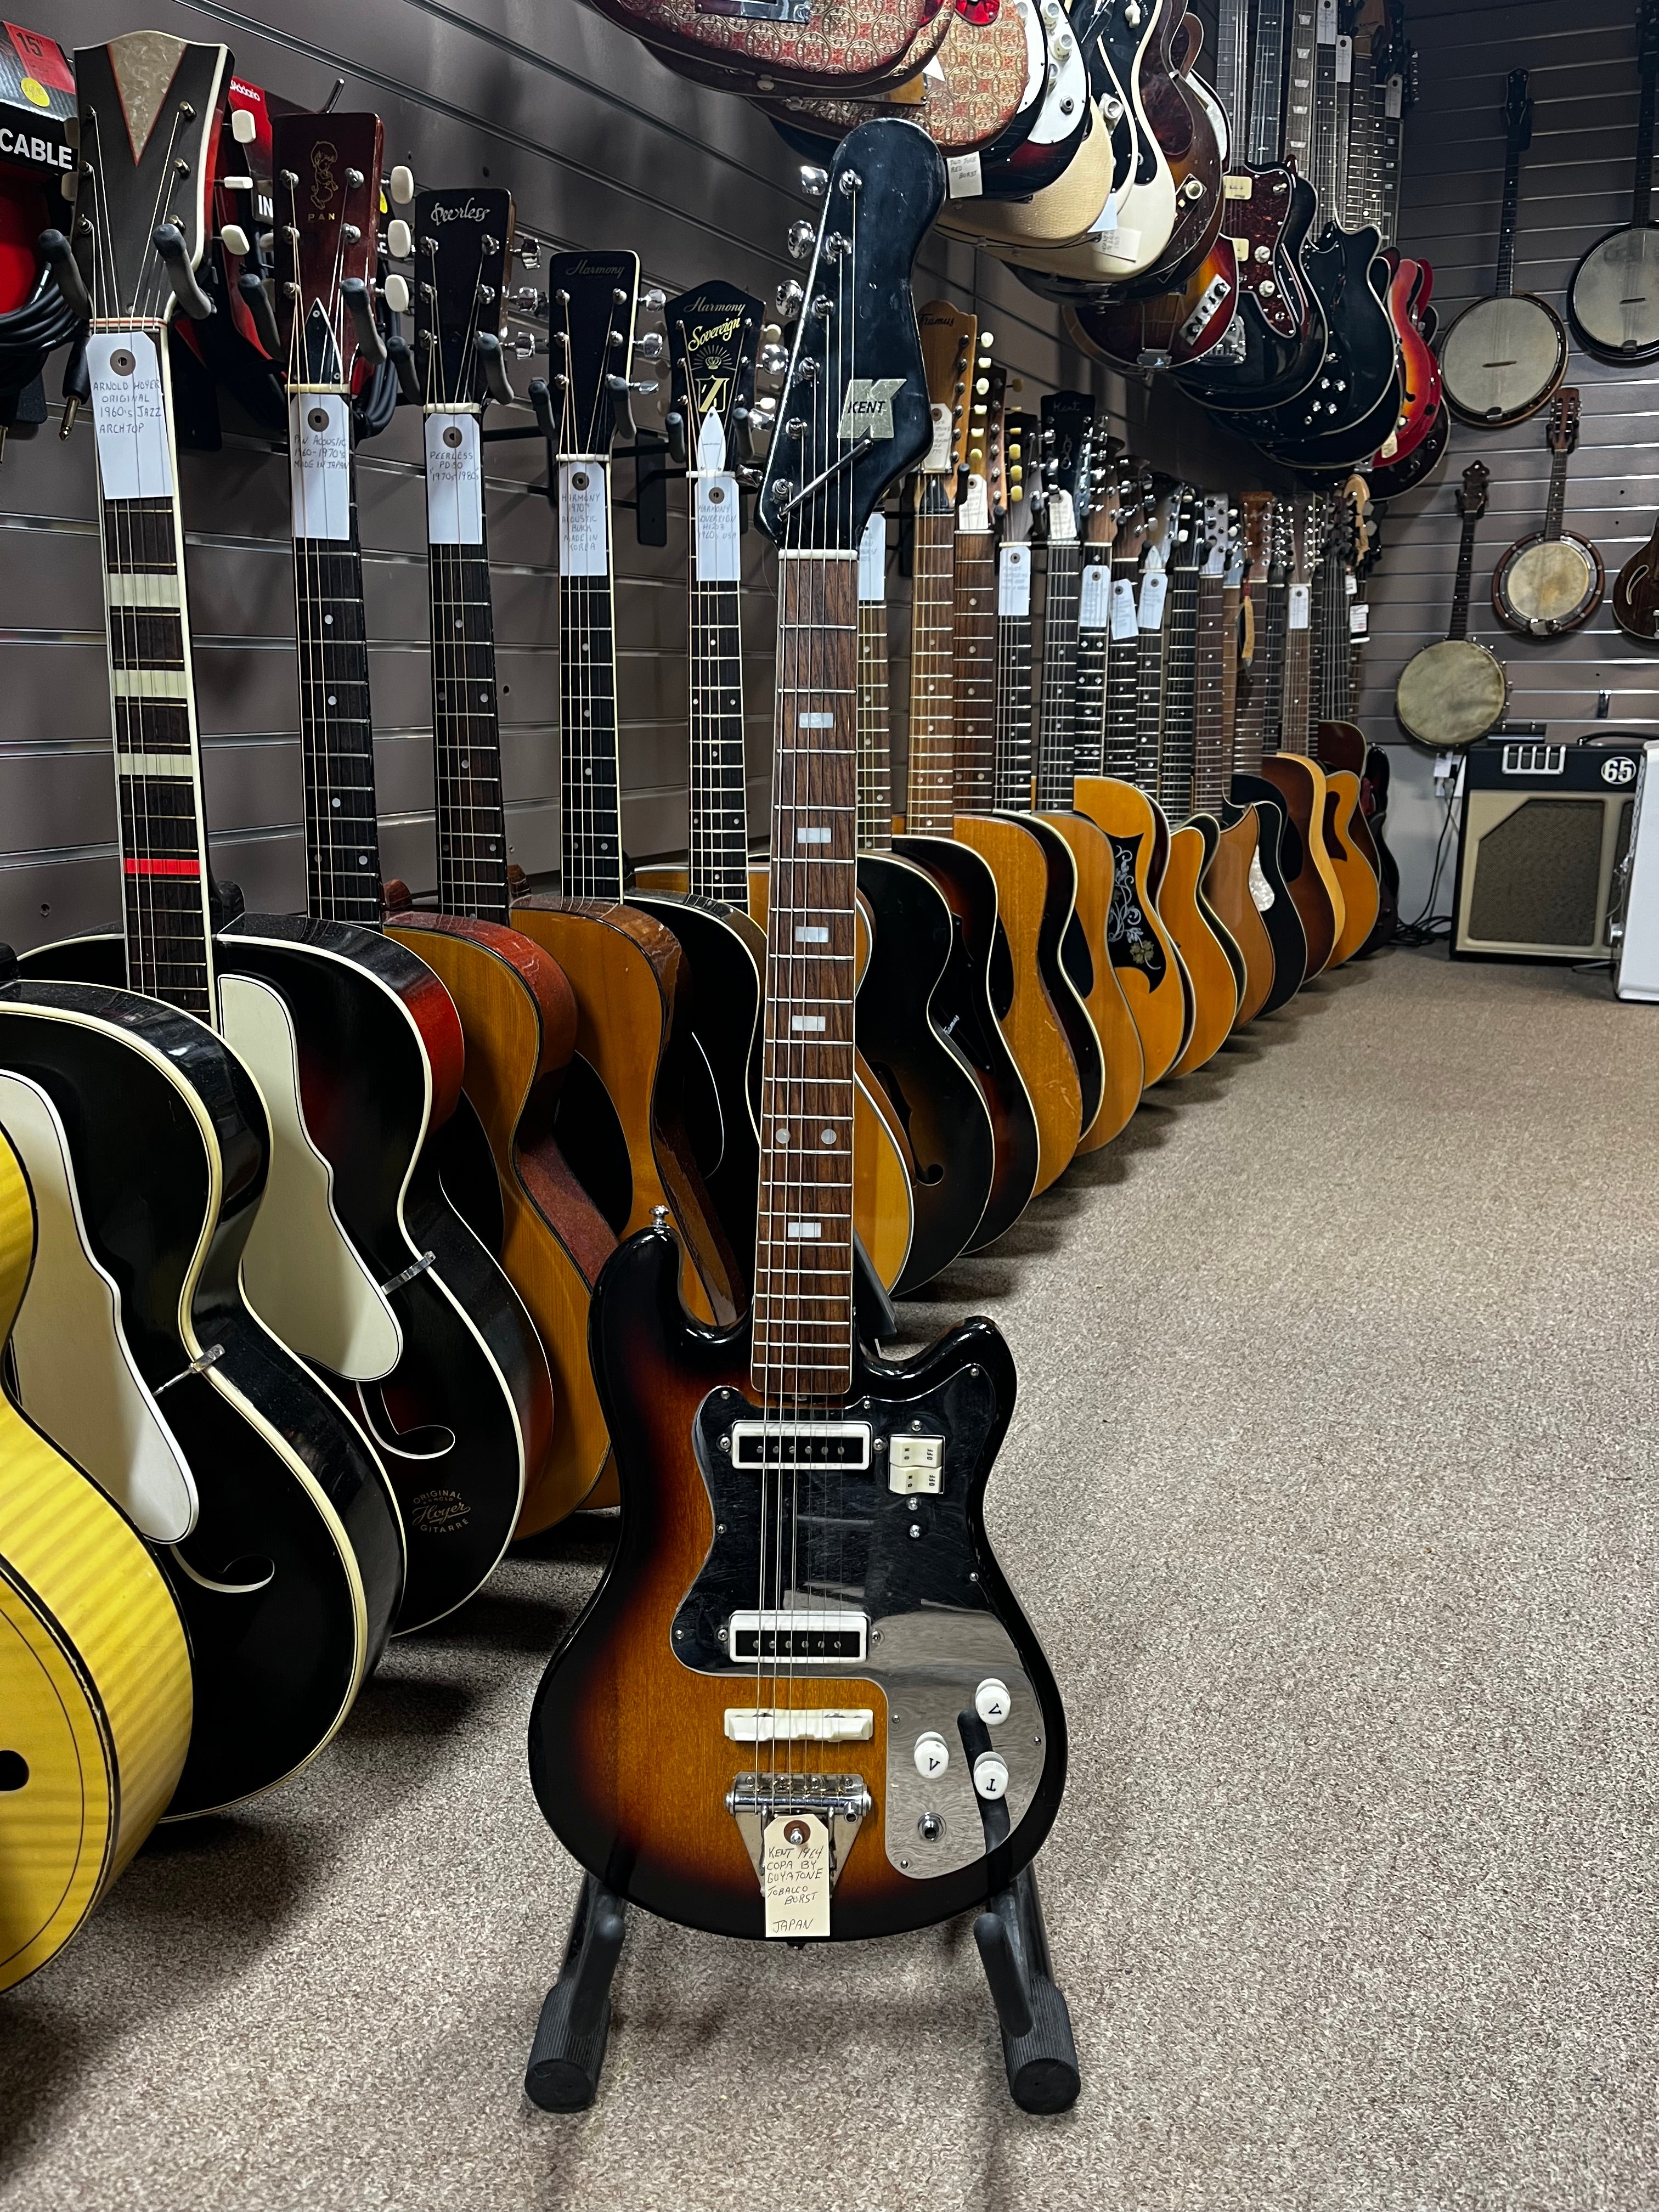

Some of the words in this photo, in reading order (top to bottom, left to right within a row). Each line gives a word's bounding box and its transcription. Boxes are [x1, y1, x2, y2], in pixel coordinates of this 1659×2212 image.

[0, 128, 72, 170] CABLE
[308, 213, 335, 221] PAN
[431, 198, 490, 226] Peerless
[566, 259, 624, 279] Harmony
[684, 296, 746, 317] Harmony
[688, 317, 741, 352] Sovereign
[93, 381, 128, 391] ARNOLD
[133, 379, 160, 391] HOYER
[102, 394, 150, 403] ORIGINAL
[100, 407, 133, 417] 1960's
[137, 405, 162, 417] JAZZ
[848, 401, 885, 414] KENT
[430, 451, 473, 460] PEERLESS
[698, 514, 737, 523] OVEREIGN
[1604, 760, 1633, 782] 65
[413, 1489, 461, 1504] ORIGINAL
[412, 1502, 471, 1525] Hoyer
[420, 1518, 469, 1533] GITARRE
[986, 1778, 996, 1792] T
[769, 1846, 795, 1859] KENT
[767, 1860, 793, 1871] COPA
[801, 1860, 817, 1871] BY
[768, 1868, 823, 1884] GUYATONE
[768, 1886, 808, 1898] TOBACCO
[785, 1892, 819, 1905] BURST
[772, 1918, 814, 1933] JAPAN
